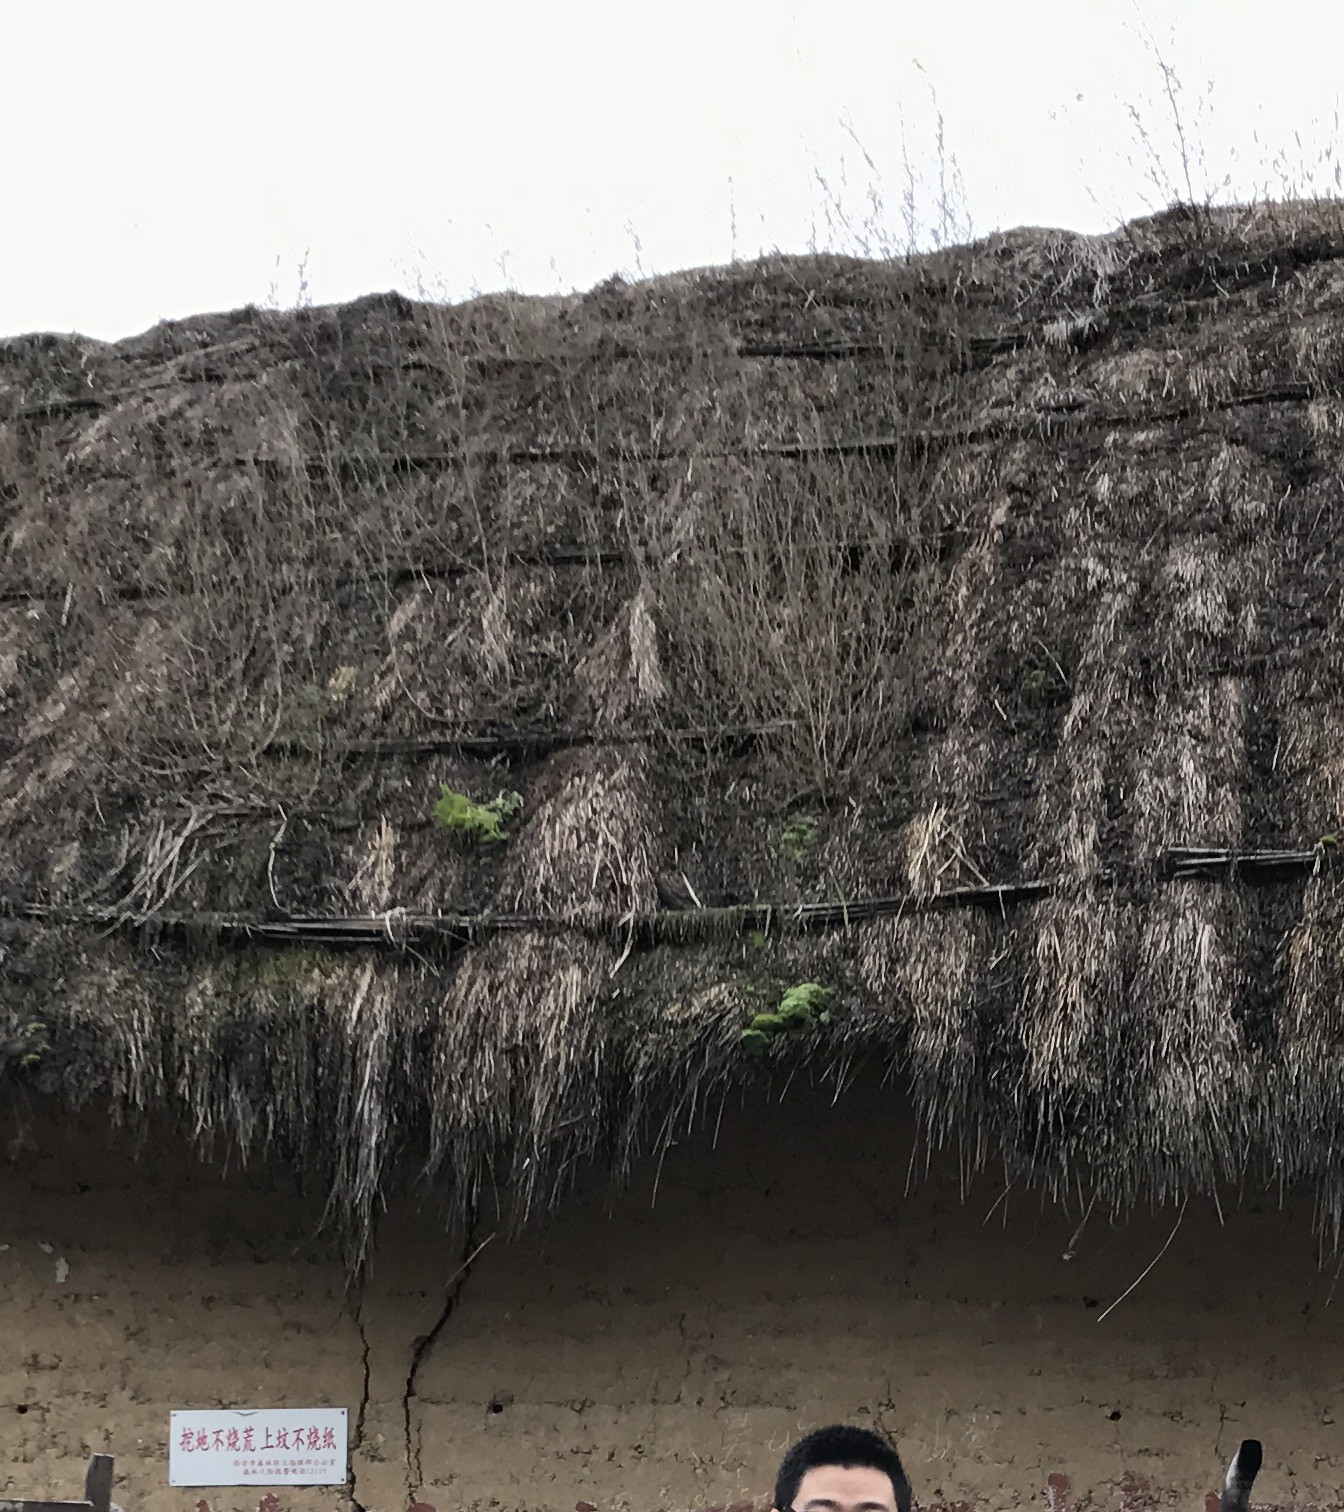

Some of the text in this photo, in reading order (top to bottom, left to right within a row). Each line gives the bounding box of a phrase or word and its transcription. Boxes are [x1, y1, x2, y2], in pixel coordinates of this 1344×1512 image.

[260, 1426, 337, 1452] 上坟不烧纸
